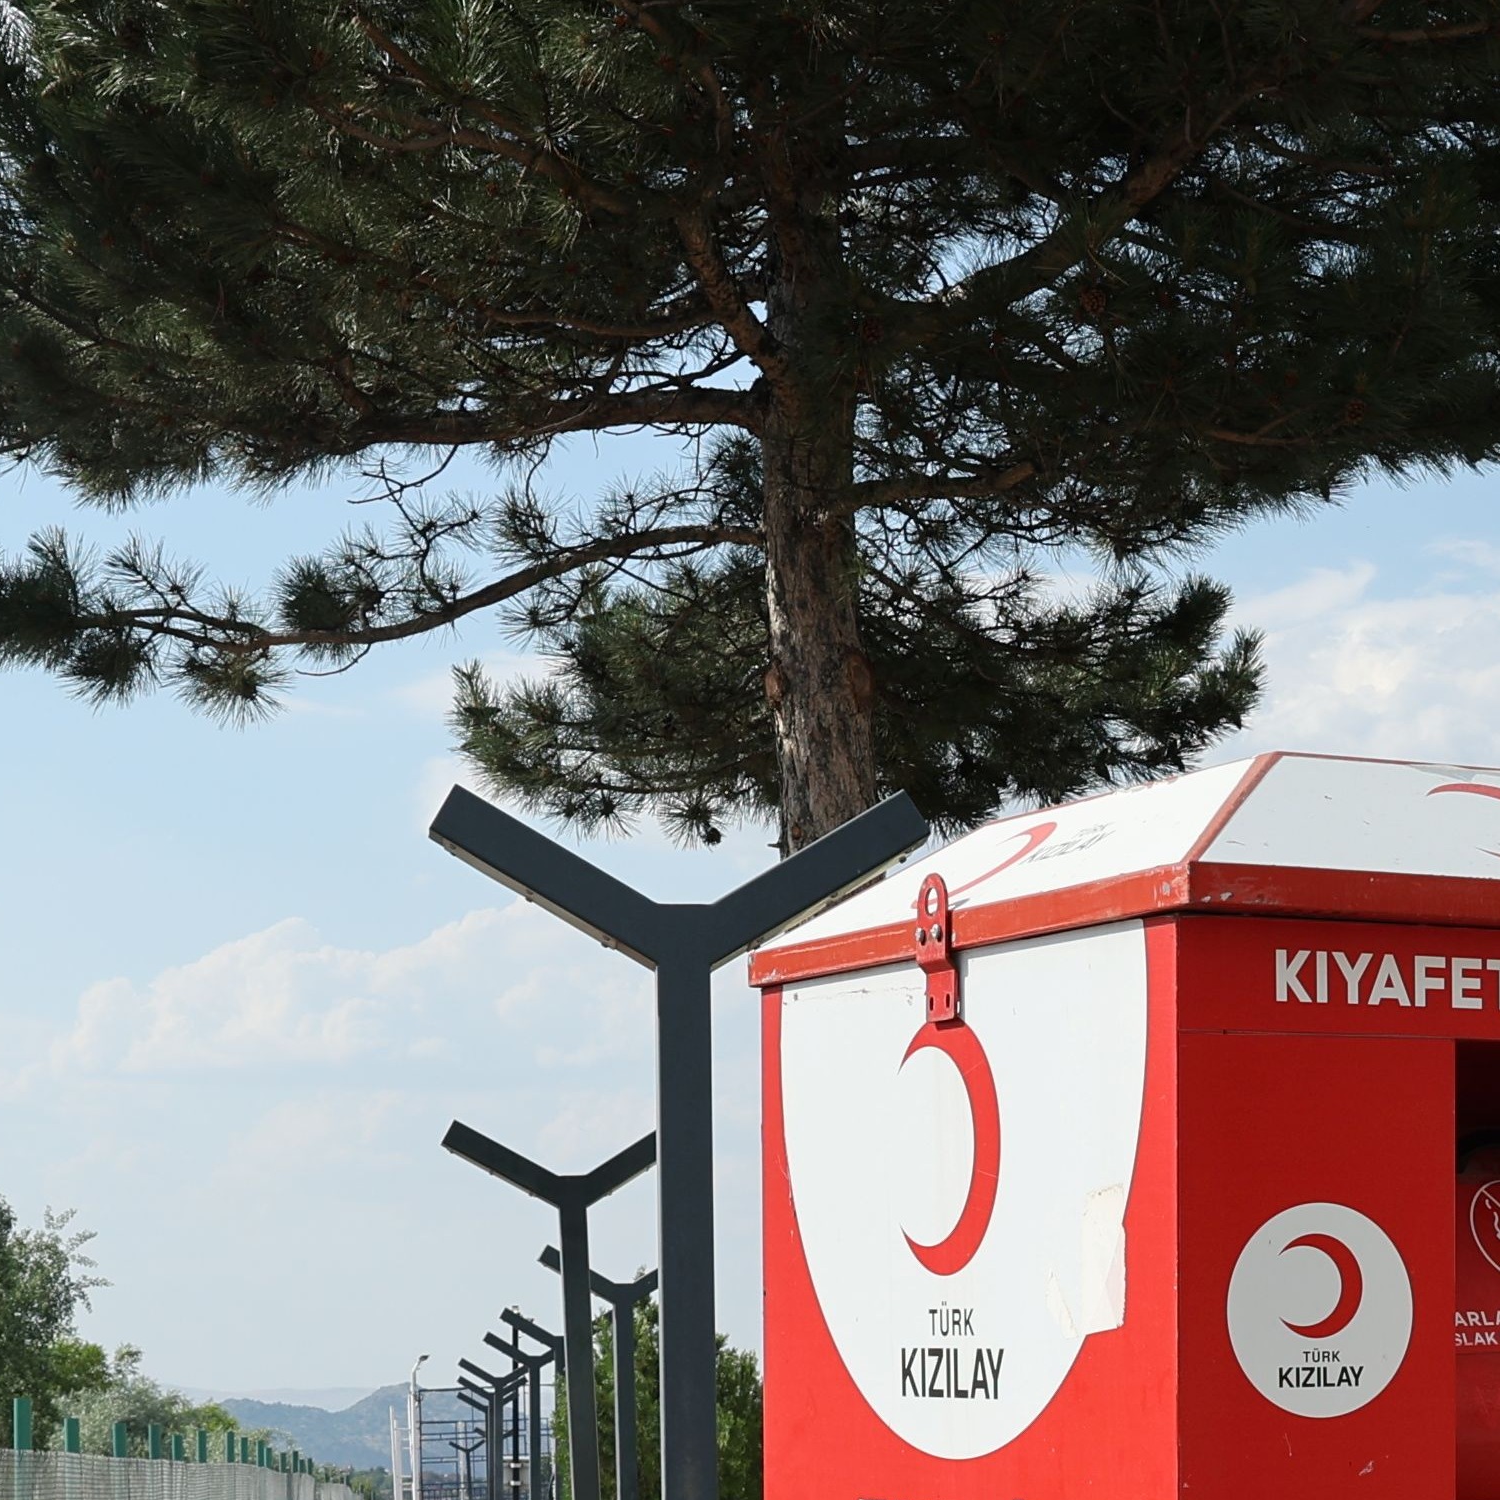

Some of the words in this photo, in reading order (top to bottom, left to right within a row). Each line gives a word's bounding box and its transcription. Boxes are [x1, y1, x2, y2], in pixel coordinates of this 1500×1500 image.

[928, 1301, 974, 1336] TÜRK
[1302, 1348, 1341, 1363] TÜRK
[901, 1347, 1004, 1400] KIZILAY
[1278, 1365, 1364, 1388] KIZILAY
